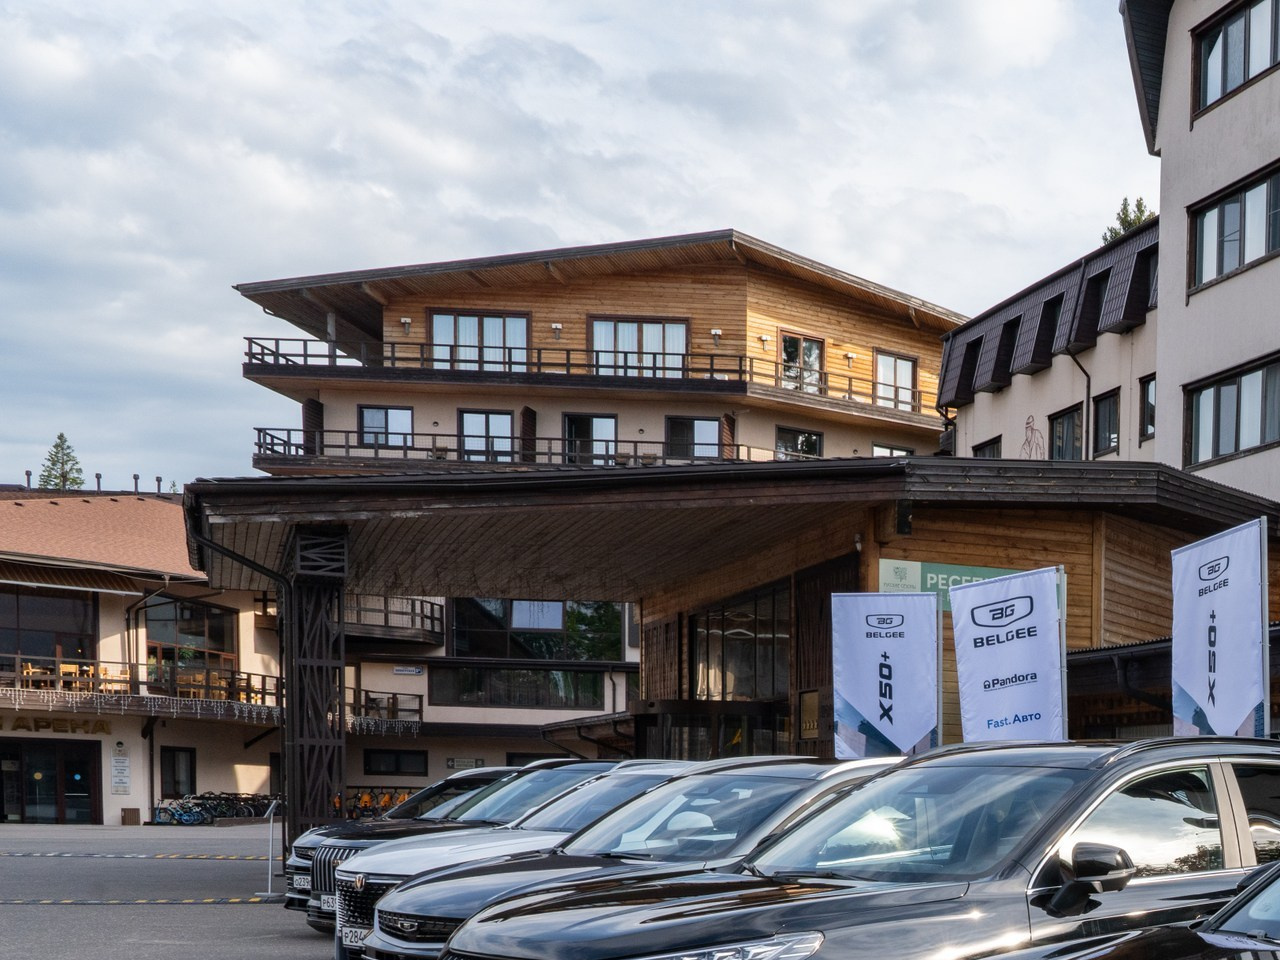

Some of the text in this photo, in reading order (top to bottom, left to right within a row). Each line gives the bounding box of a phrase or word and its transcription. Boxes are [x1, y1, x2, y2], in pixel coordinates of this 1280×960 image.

[1198, 578, 1229, 597] BELGEE
[973, 626, 1038, 648] BELGEE
[879, 651, 894, 725] X50+
[992, 672, 1038, 688] Pandora
[11, 717, 112, 735] АРЕНА
